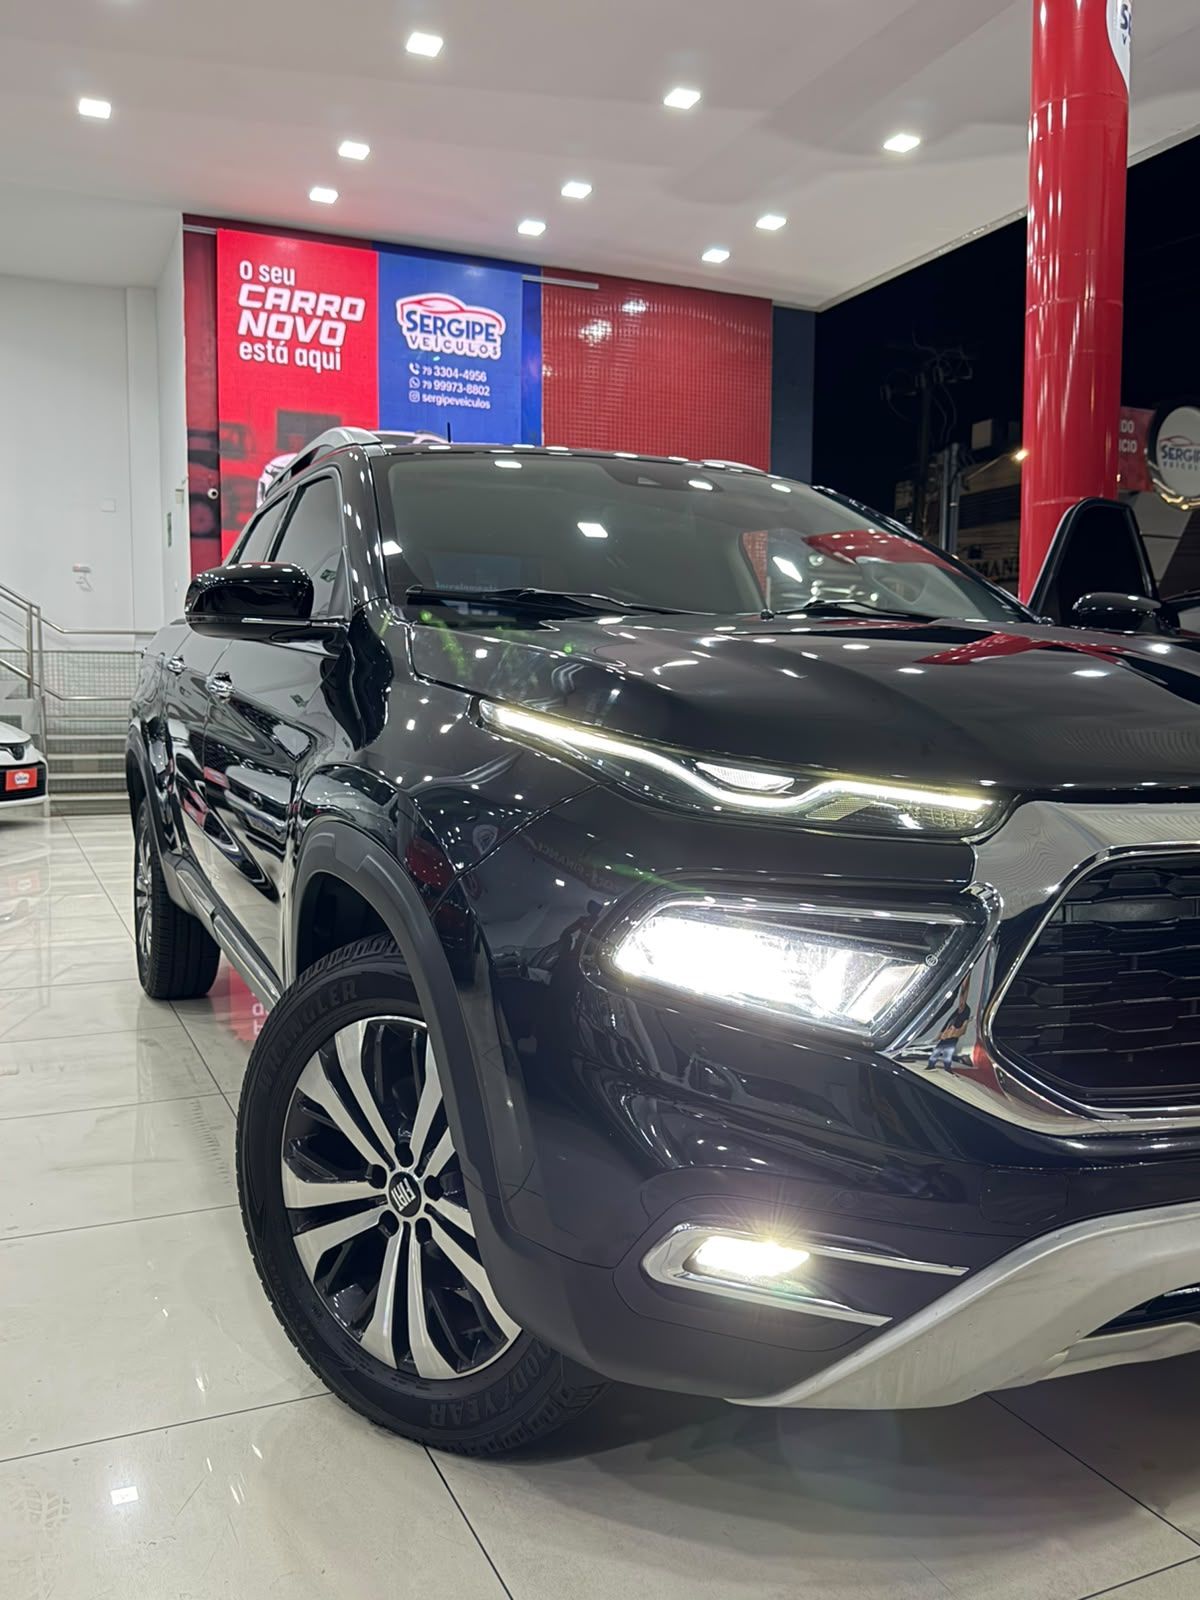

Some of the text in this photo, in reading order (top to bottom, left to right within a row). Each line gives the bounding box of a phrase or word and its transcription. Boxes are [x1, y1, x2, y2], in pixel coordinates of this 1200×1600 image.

[239, 260, 296, 286] O seu
[238, 283, 366, 322] CARRO
[237, 309, 347, 347] NOVO
[405, 310, 497, 343] SERGIPE
[239, 340, 341, 374] está aqui
[410, 335, 498, 356] VEÍCULOS
[422, 365, 487, 383] 79 3304-4956
[422, 380, 490, 397] 79 99973-8802
[421, 393, 491, 409] sergipeveiculos
[391, 1177, 416, 1211] FIAT
